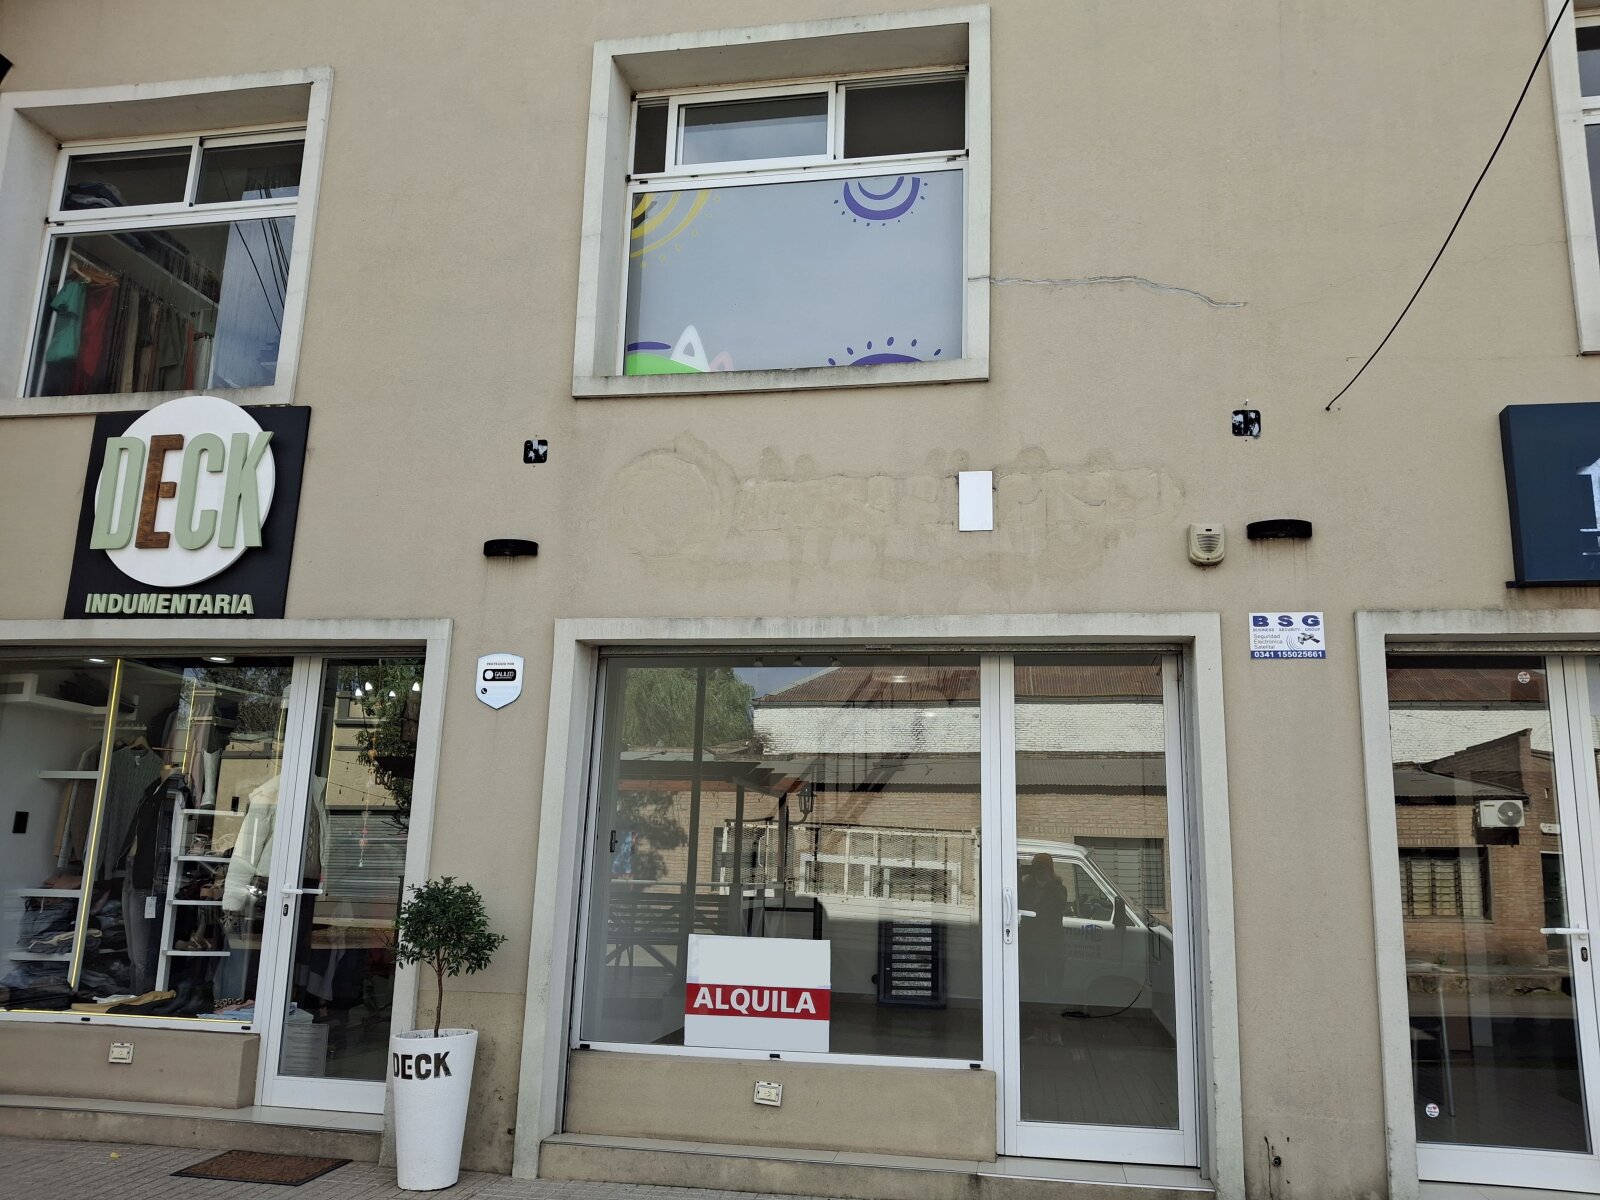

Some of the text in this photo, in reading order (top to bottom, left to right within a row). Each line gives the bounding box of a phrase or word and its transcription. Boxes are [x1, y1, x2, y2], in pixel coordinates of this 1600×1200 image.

[90, 431, 274, 550] DECK
[84, 593, 254, 615] INDUMENTARIA
[693, 986, 816, 1015] ALQUILA
[392, 1051, 453, 1081] DECK
